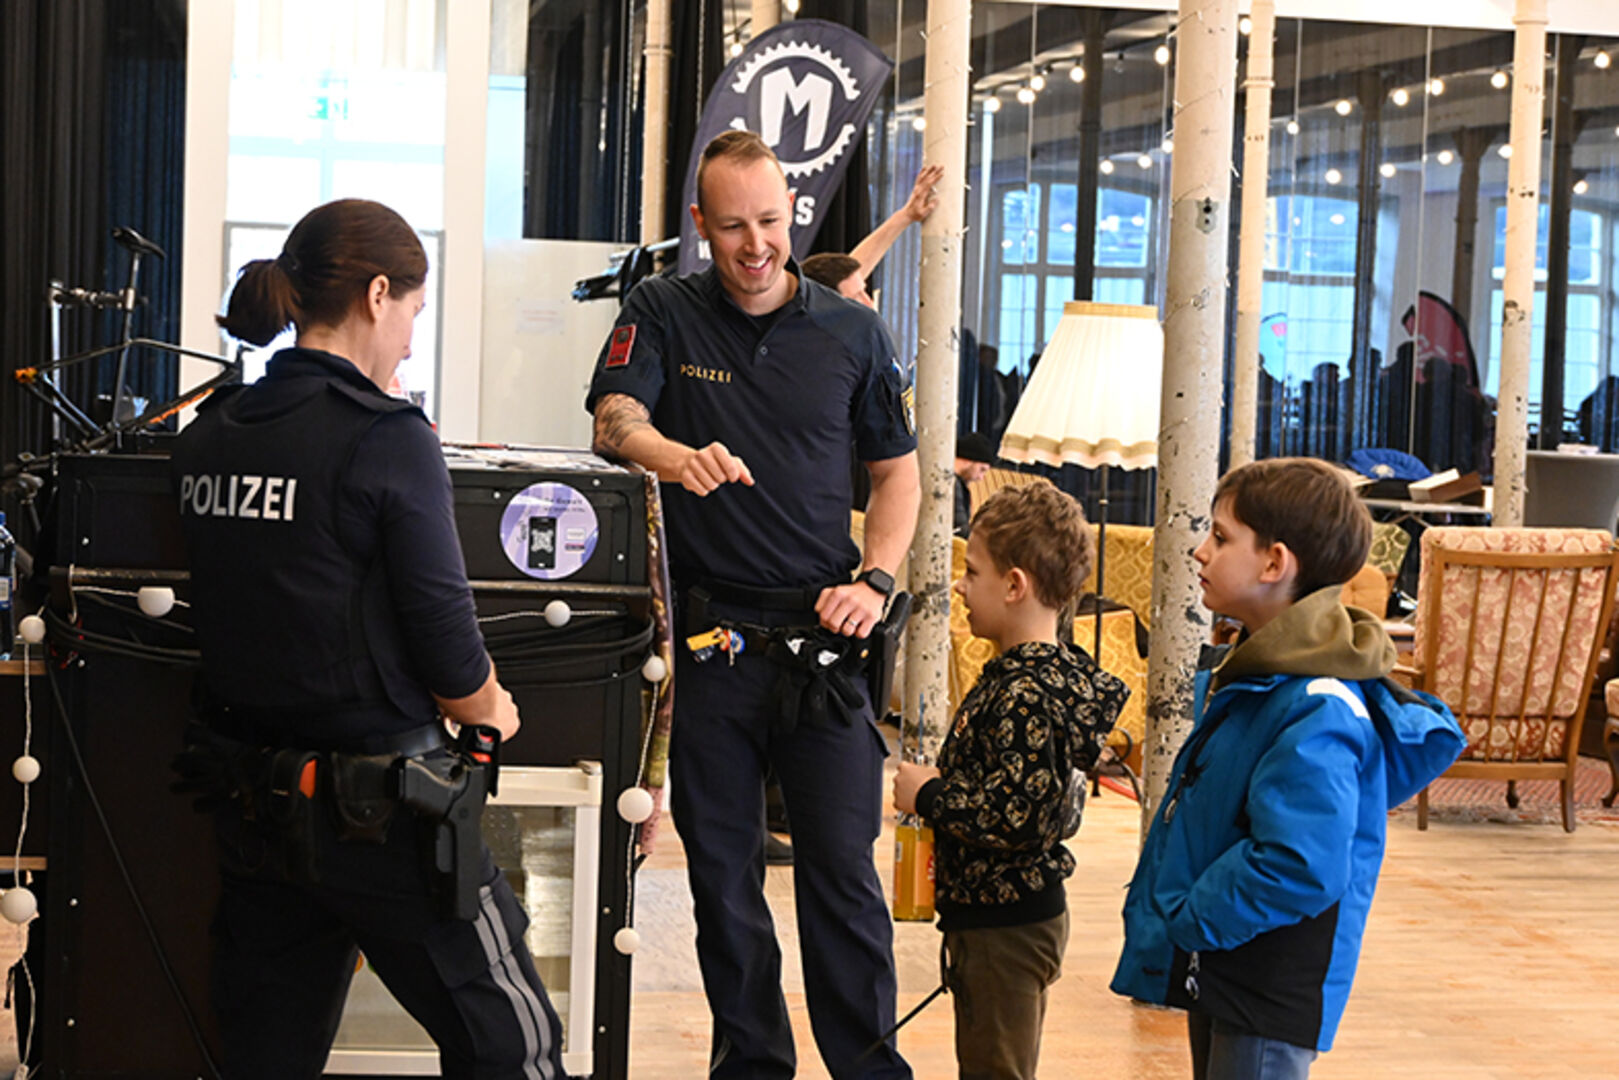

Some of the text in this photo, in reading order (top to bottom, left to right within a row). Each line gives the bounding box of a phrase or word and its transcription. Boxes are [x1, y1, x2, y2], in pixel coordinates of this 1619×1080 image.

[760, 66, 834, 152] M
[680, 364, 732, 384] POLIZEI
[180, 474, 297, 521] POLIZEI
